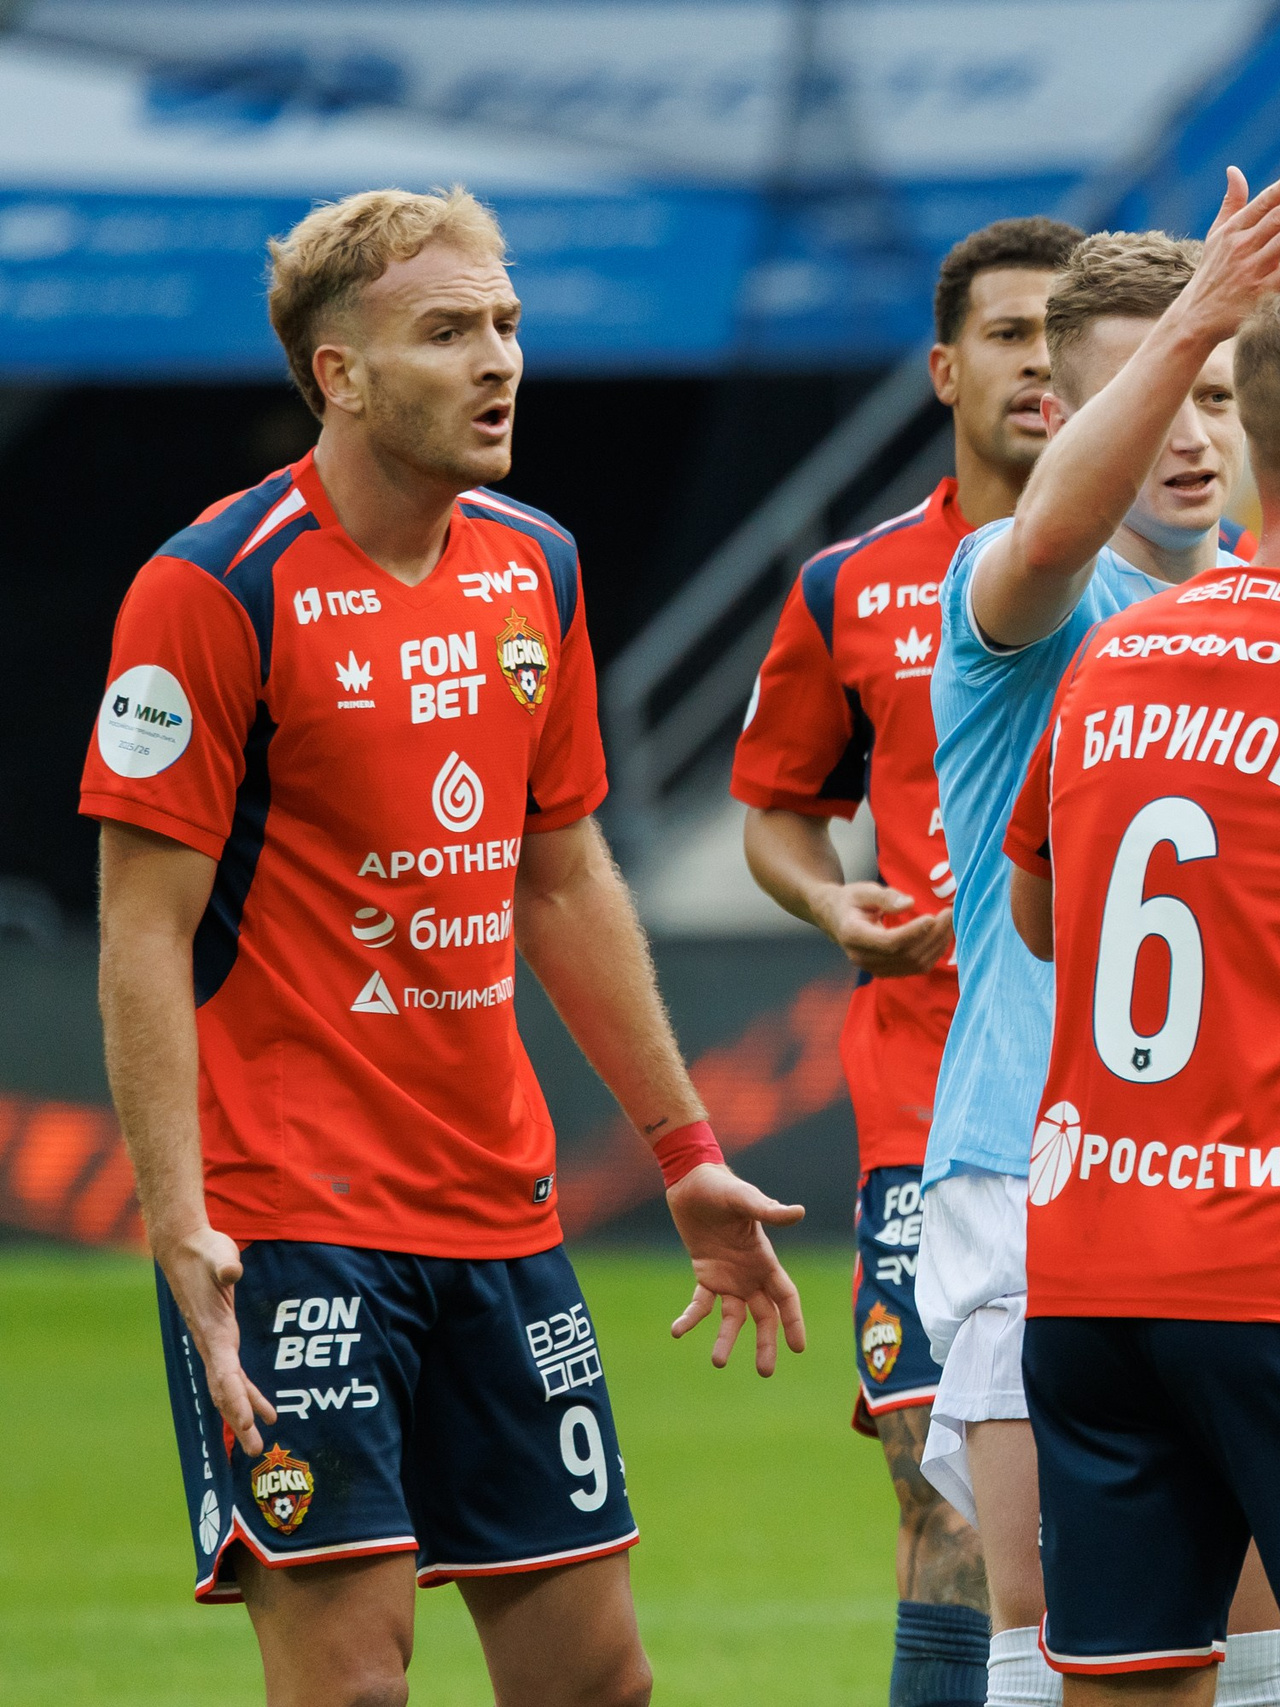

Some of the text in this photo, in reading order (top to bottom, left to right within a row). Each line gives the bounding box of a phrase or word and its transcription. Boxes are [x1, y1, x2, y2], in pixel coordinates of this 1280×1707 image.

[326, 588, 381, 616] ПСБ
[896, 582, 943, 608] ПС
[401, 630, 477, 681] FON
[502, 638, 547, 670] ЦСКА
[134, 703, 183, 728] МИР
[410, 673, 487, 724] BET
[1093, 796, 1218, 1084] 6
[883, 1181, 925, 1221] FO
[874, 1217, 923, 1246] BE
[273, 1297, 362, 1334] FON
[525, 1302, 592, 1359] ВЭБ
[274, 1333, 362, 1370] BET
[539, 1347, 604, 1403] РФ
[559, 1405, 609, 1512] 9
[256, 1469, 311, 1499] ЦСКА
